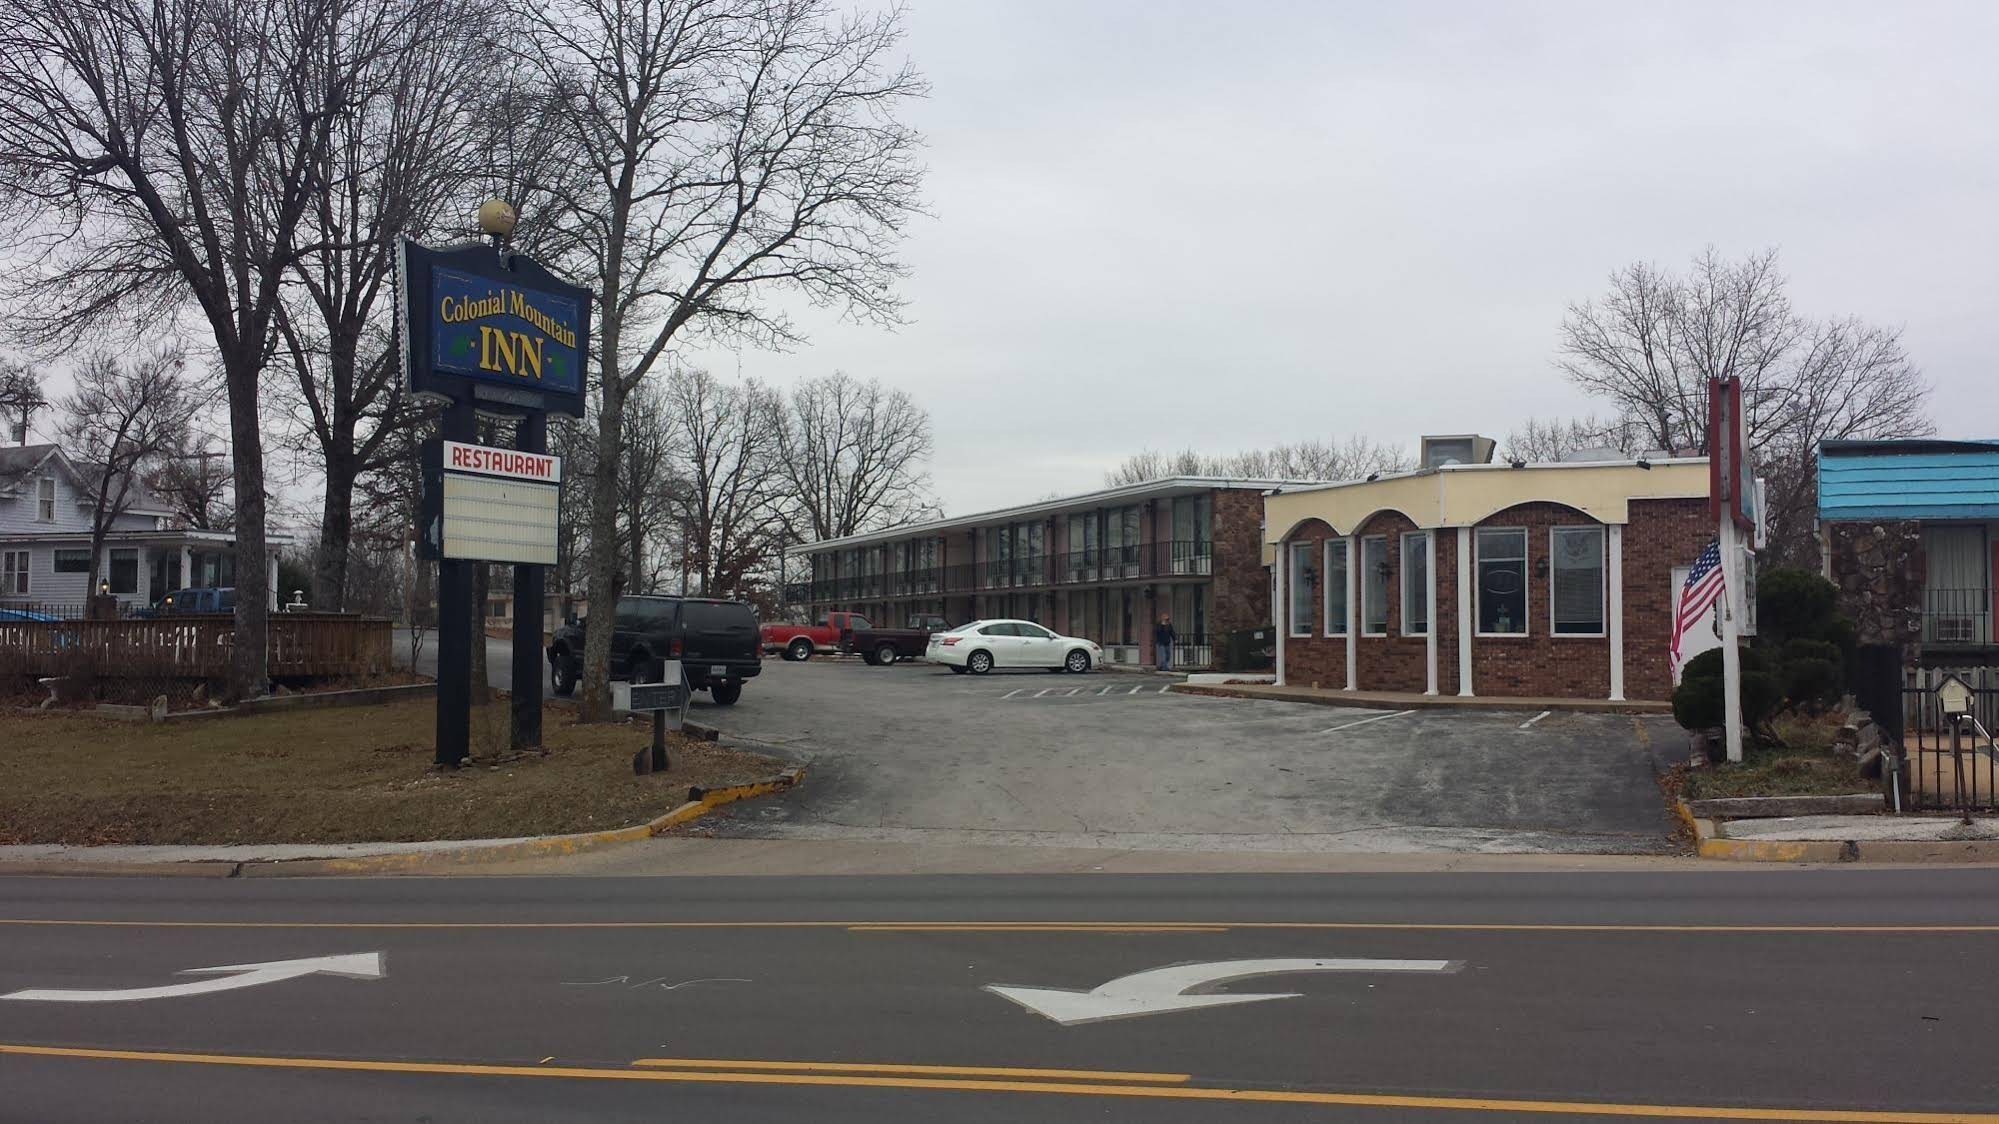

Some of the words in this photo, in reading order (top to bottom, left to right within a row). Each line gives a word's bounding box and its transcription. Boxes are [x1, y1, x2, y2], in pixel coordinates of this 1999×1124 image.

[441, 289, 506, 323] Colonial
[510, 290, 577, 349] Mountain
[479, 325, 544, 379] INN
[452, 446, 553, 478] RESTAURANT
